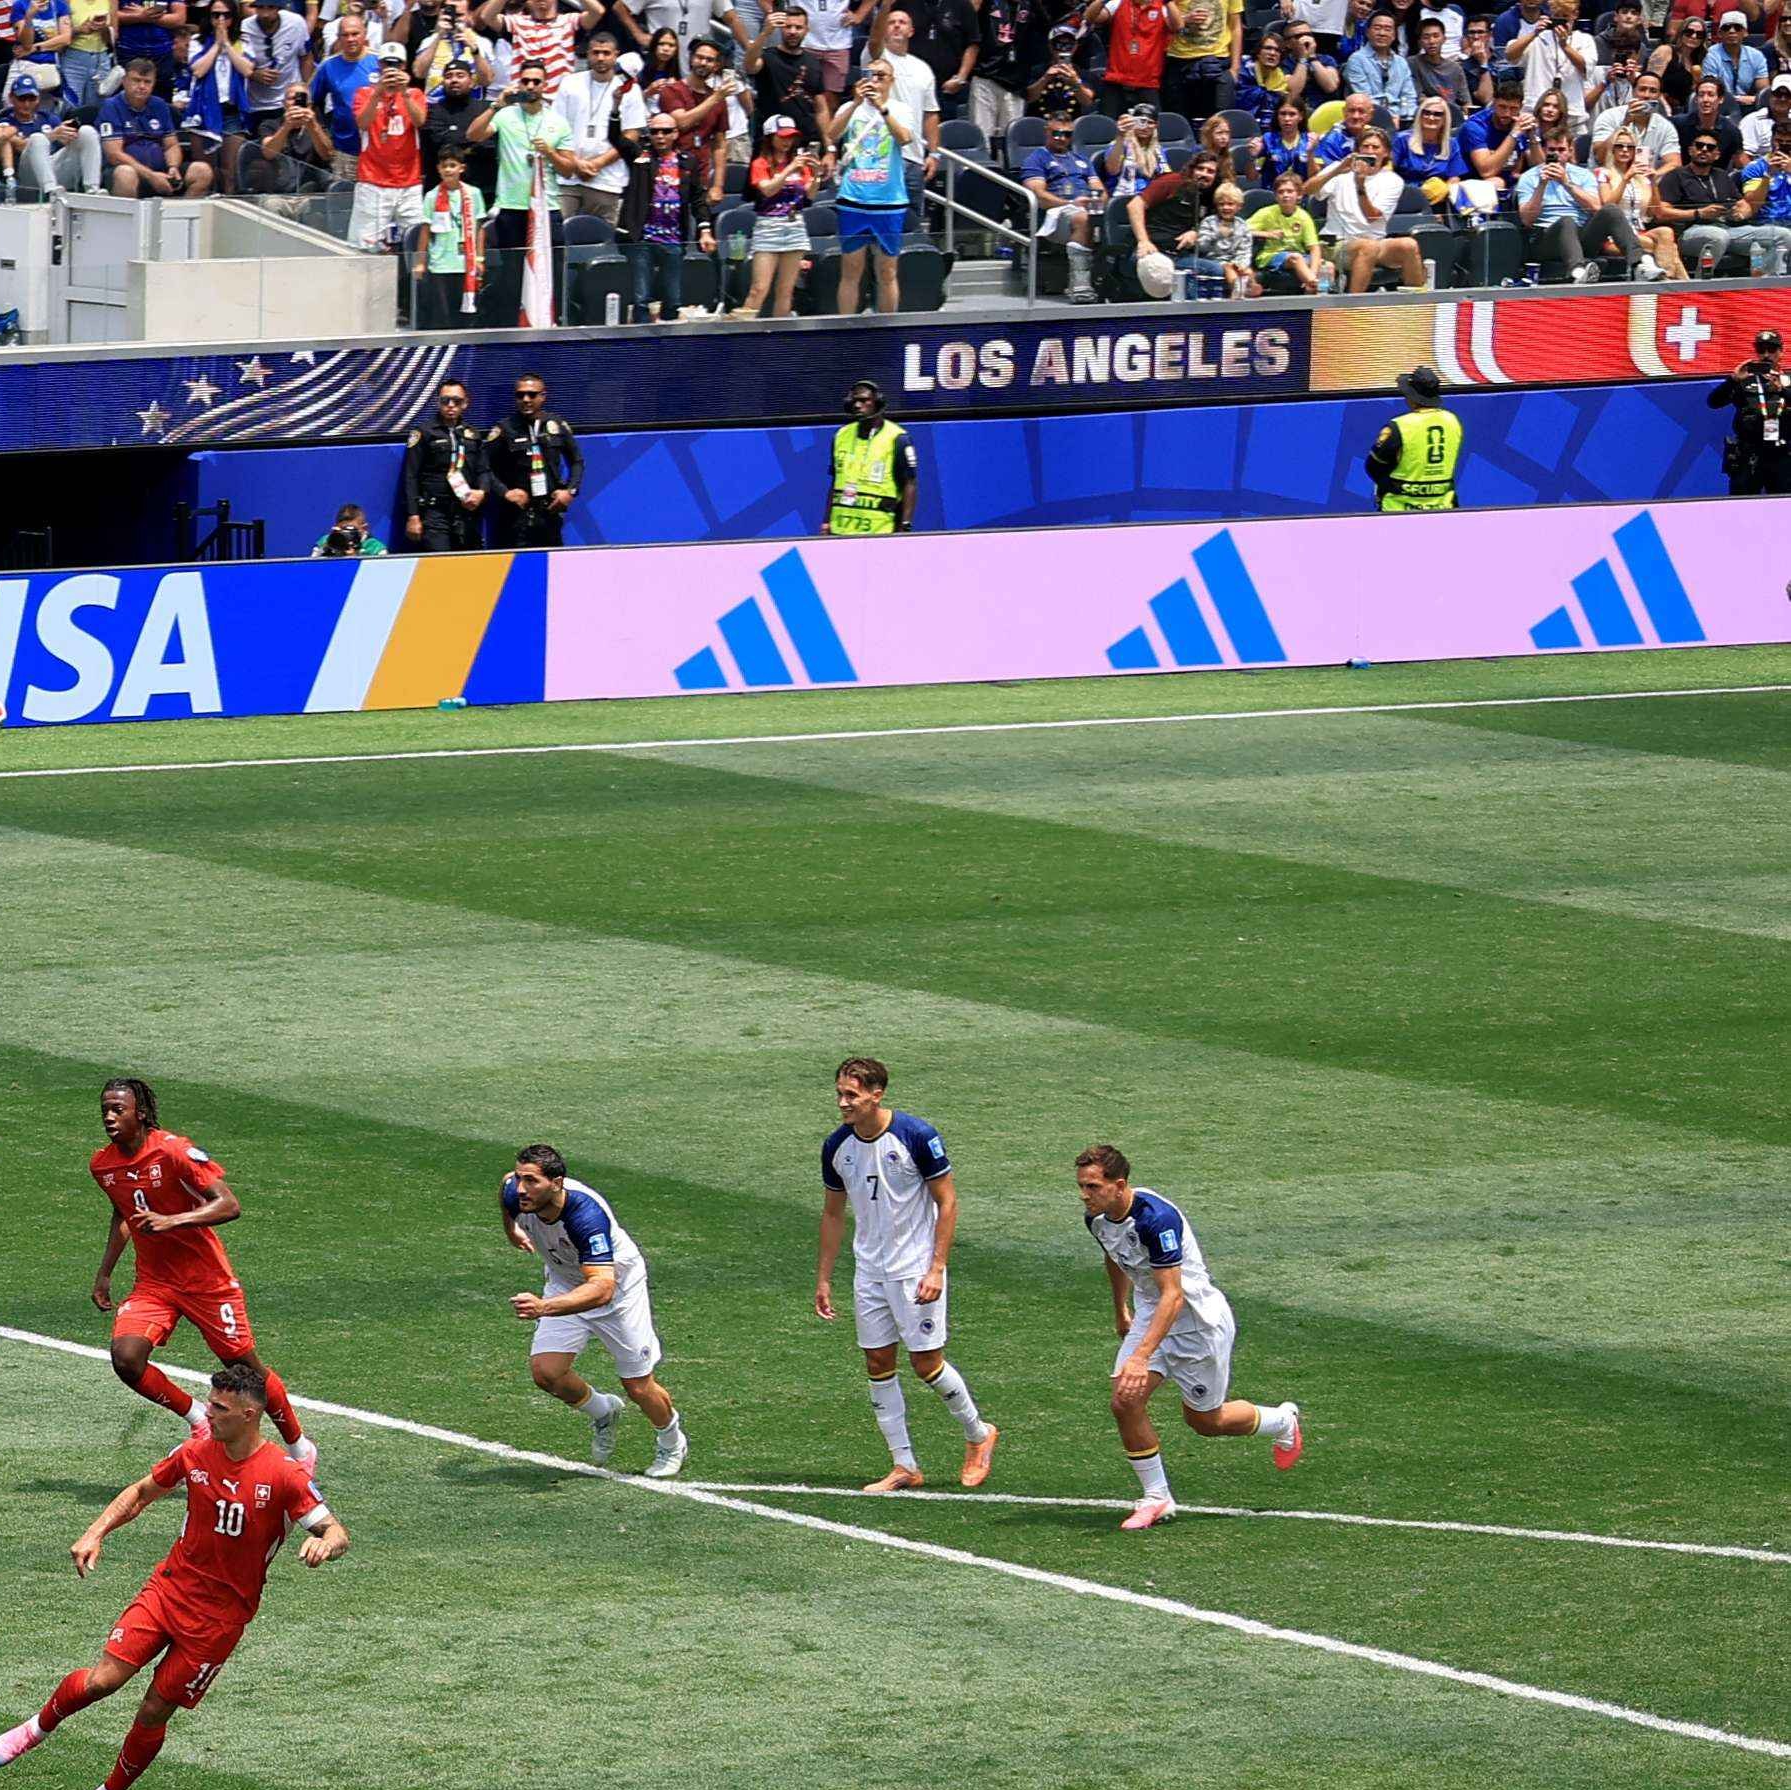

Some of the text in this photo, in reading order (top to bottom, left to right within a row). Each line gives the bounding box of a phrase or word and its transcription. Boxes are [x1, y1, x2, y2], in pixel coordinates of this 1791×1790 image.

[903, 328, 1291, 392] LOS ANGELES
[866, 1174, 879, 1201] 7
[219, 1302, 238, 1336] 9
[213, 1499, 246, 1538] 10
